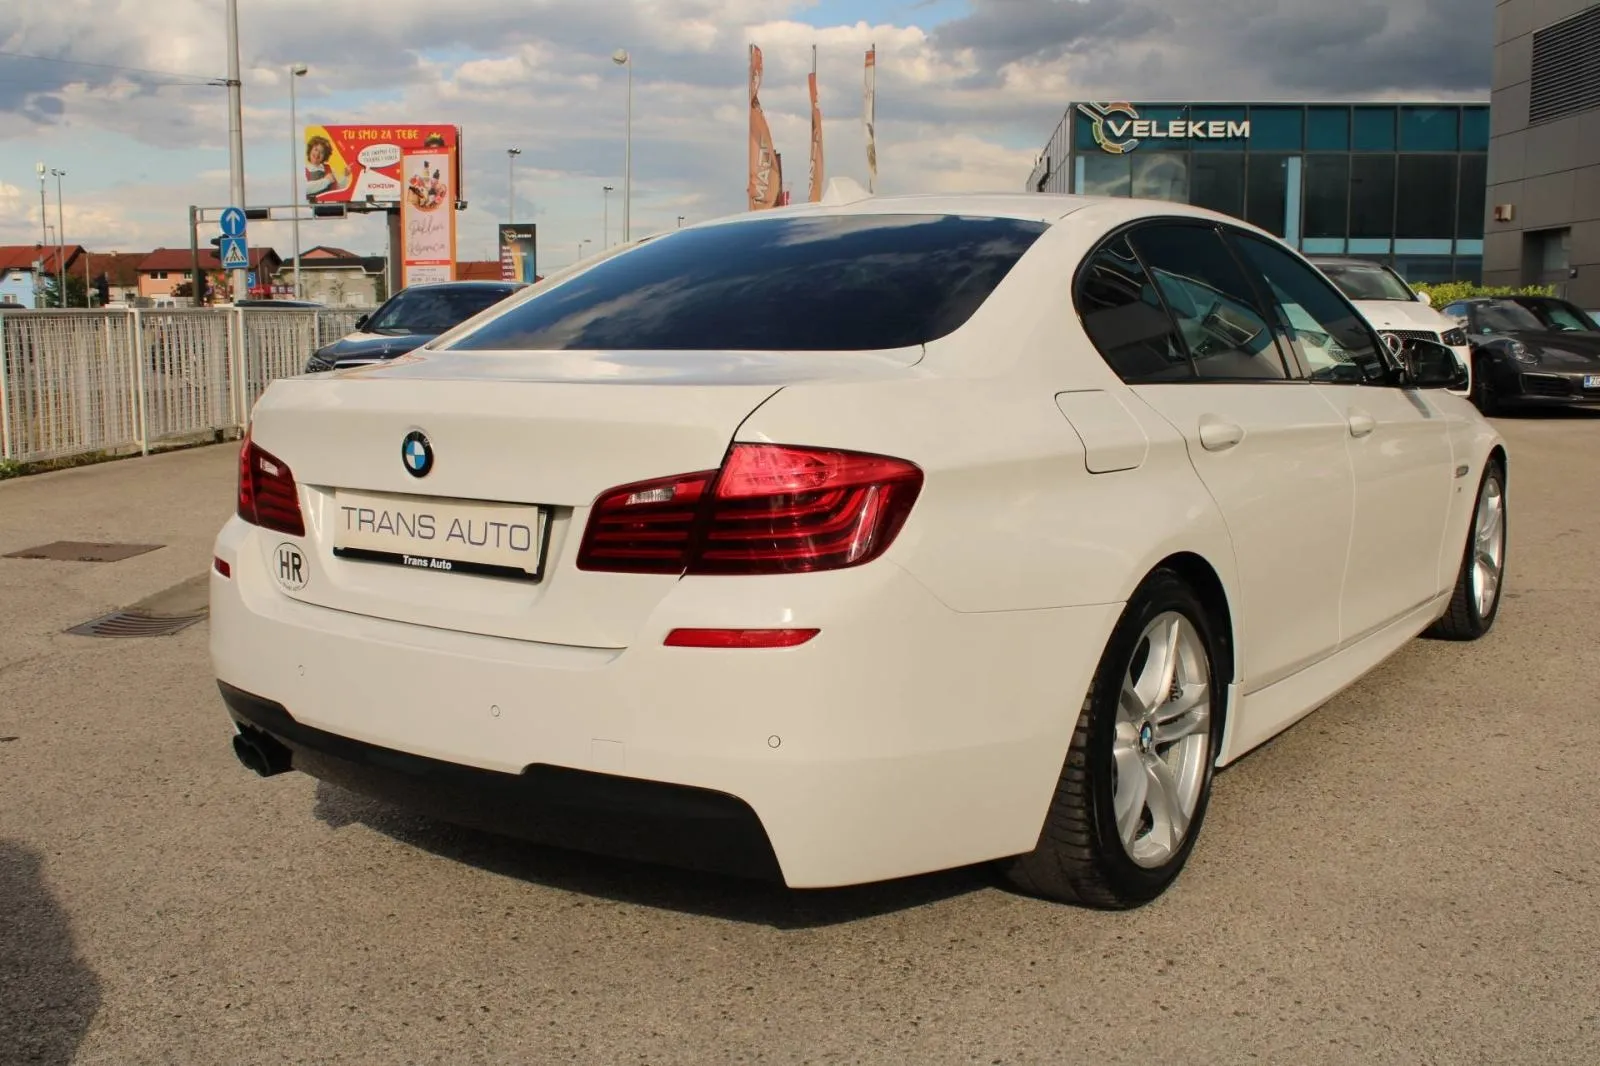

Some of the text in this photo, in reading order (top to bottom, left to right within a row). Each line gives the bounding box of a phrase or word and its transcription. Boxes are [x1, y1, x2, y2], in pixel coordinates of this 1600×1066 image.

[343, 129, 418, 140] TU SMO ZA TEBE
[1106, 120, 1250, 138] VELEKEM
[341, 506, 531, 551] TRANS AUTO
[279, 549, 303, 583] HR
[403, 555, 452, 570] Trans Auto
